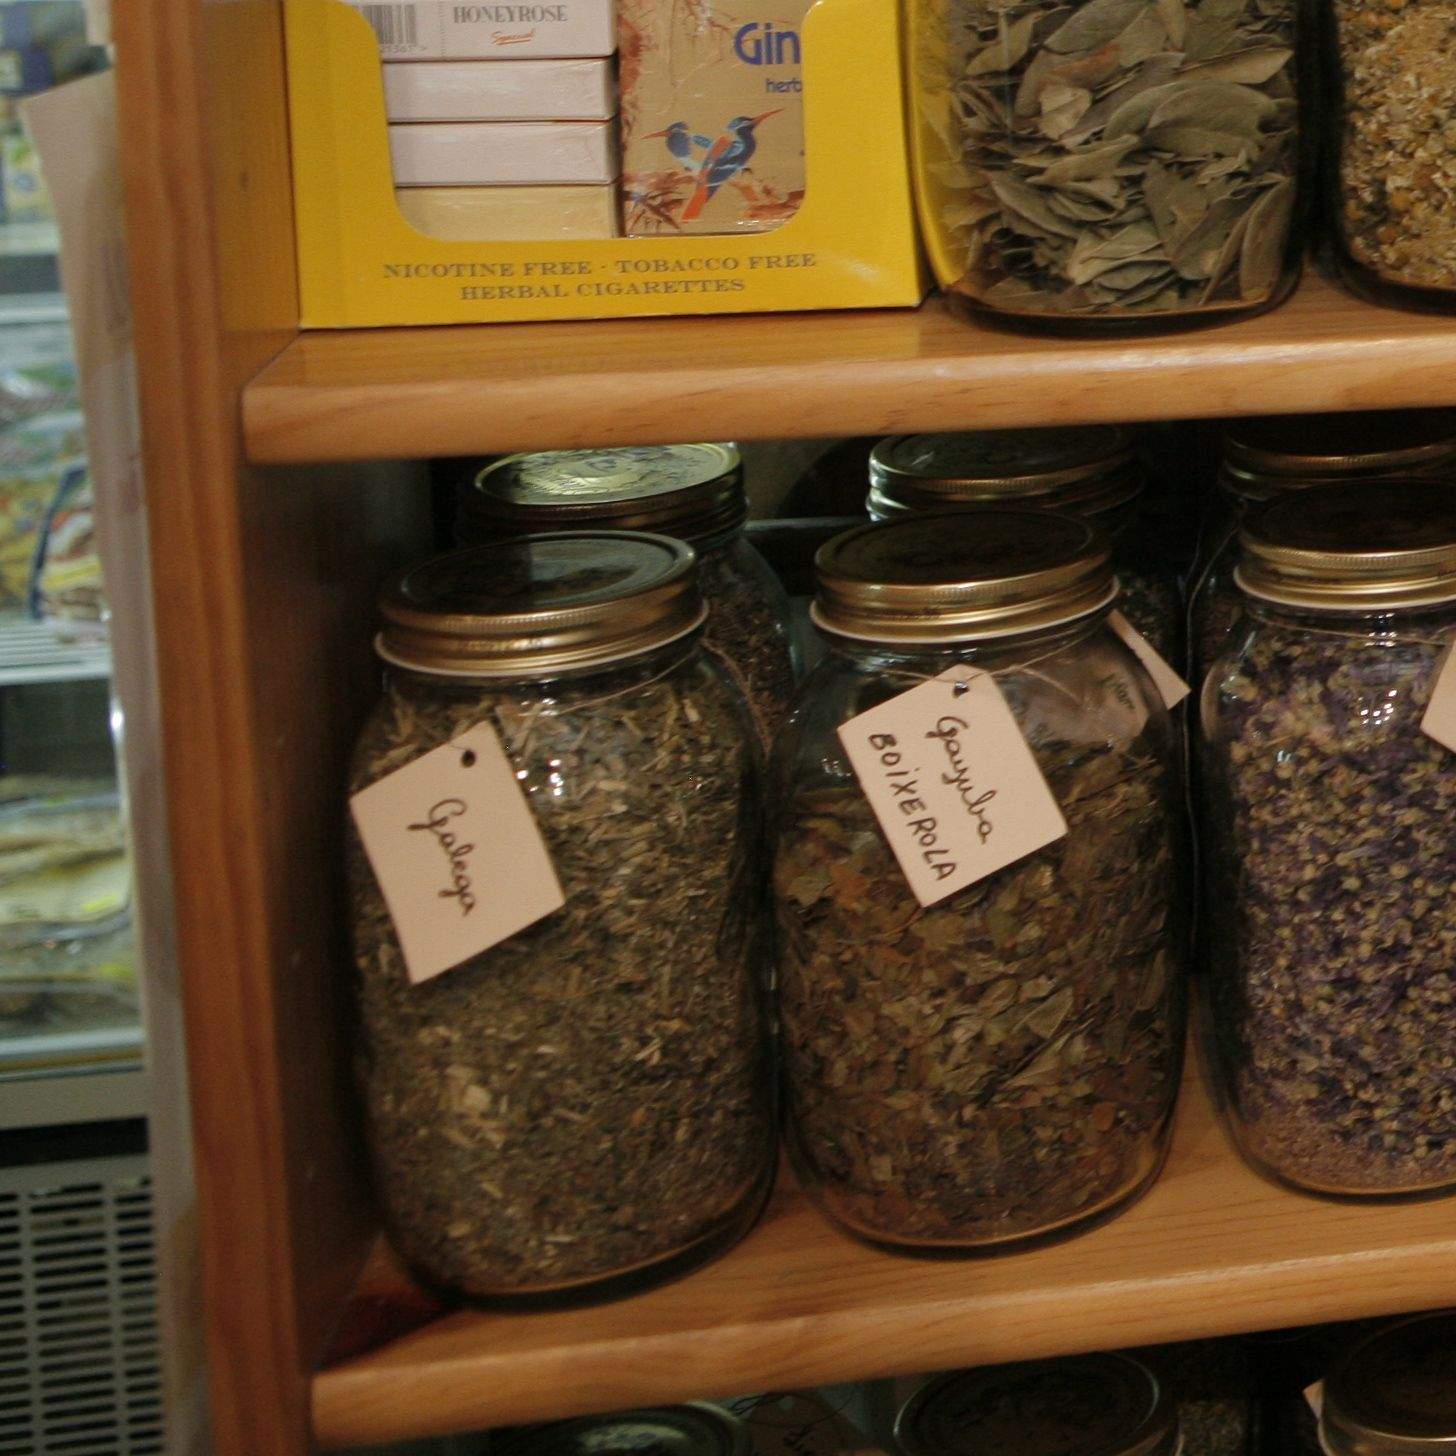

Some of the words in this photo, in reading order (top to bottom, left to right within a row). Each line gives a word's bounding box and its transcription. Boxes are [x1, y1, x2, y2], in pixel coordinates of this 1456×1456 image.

[453, 4, 568, 24] HONEYROSE
[383, 263, 514, 279] NICOTINE
[522, 262, 593, 277] FREE
[617, 257, 739, 274] TOBACCO
[748, 253, 817, 270] FREE
[460, 283, 566, 300] HERBAL
[575, 278, 746, 297] CIGARETTES
[927, 714, 996, 845] Gayuba
[407, 798, 478, 919] Galega
